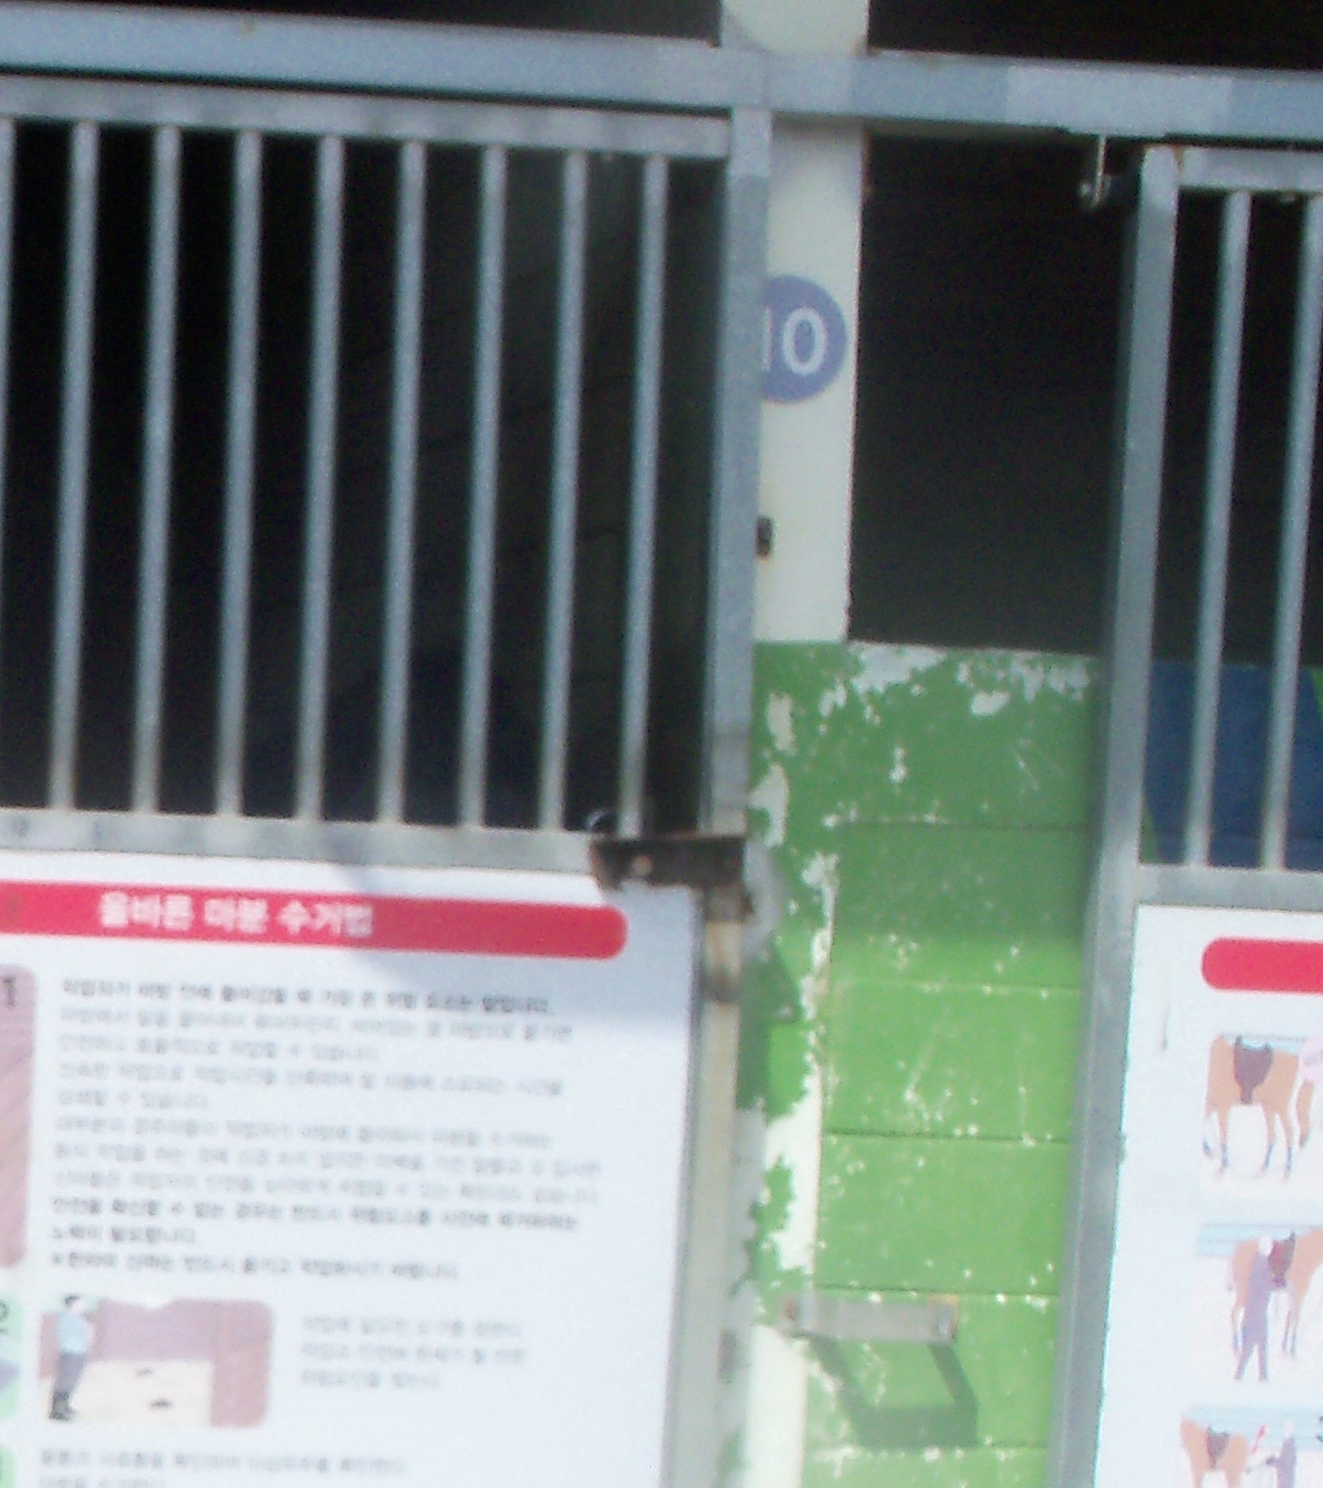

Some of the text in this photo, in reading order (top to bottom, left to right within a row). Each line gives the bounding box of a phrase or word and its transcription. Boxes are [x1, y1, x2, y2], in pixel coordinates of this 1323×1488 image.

[99, 890, 375, 939] 올바른 마분 수거법
[2, 976, 18, 1009] 1
